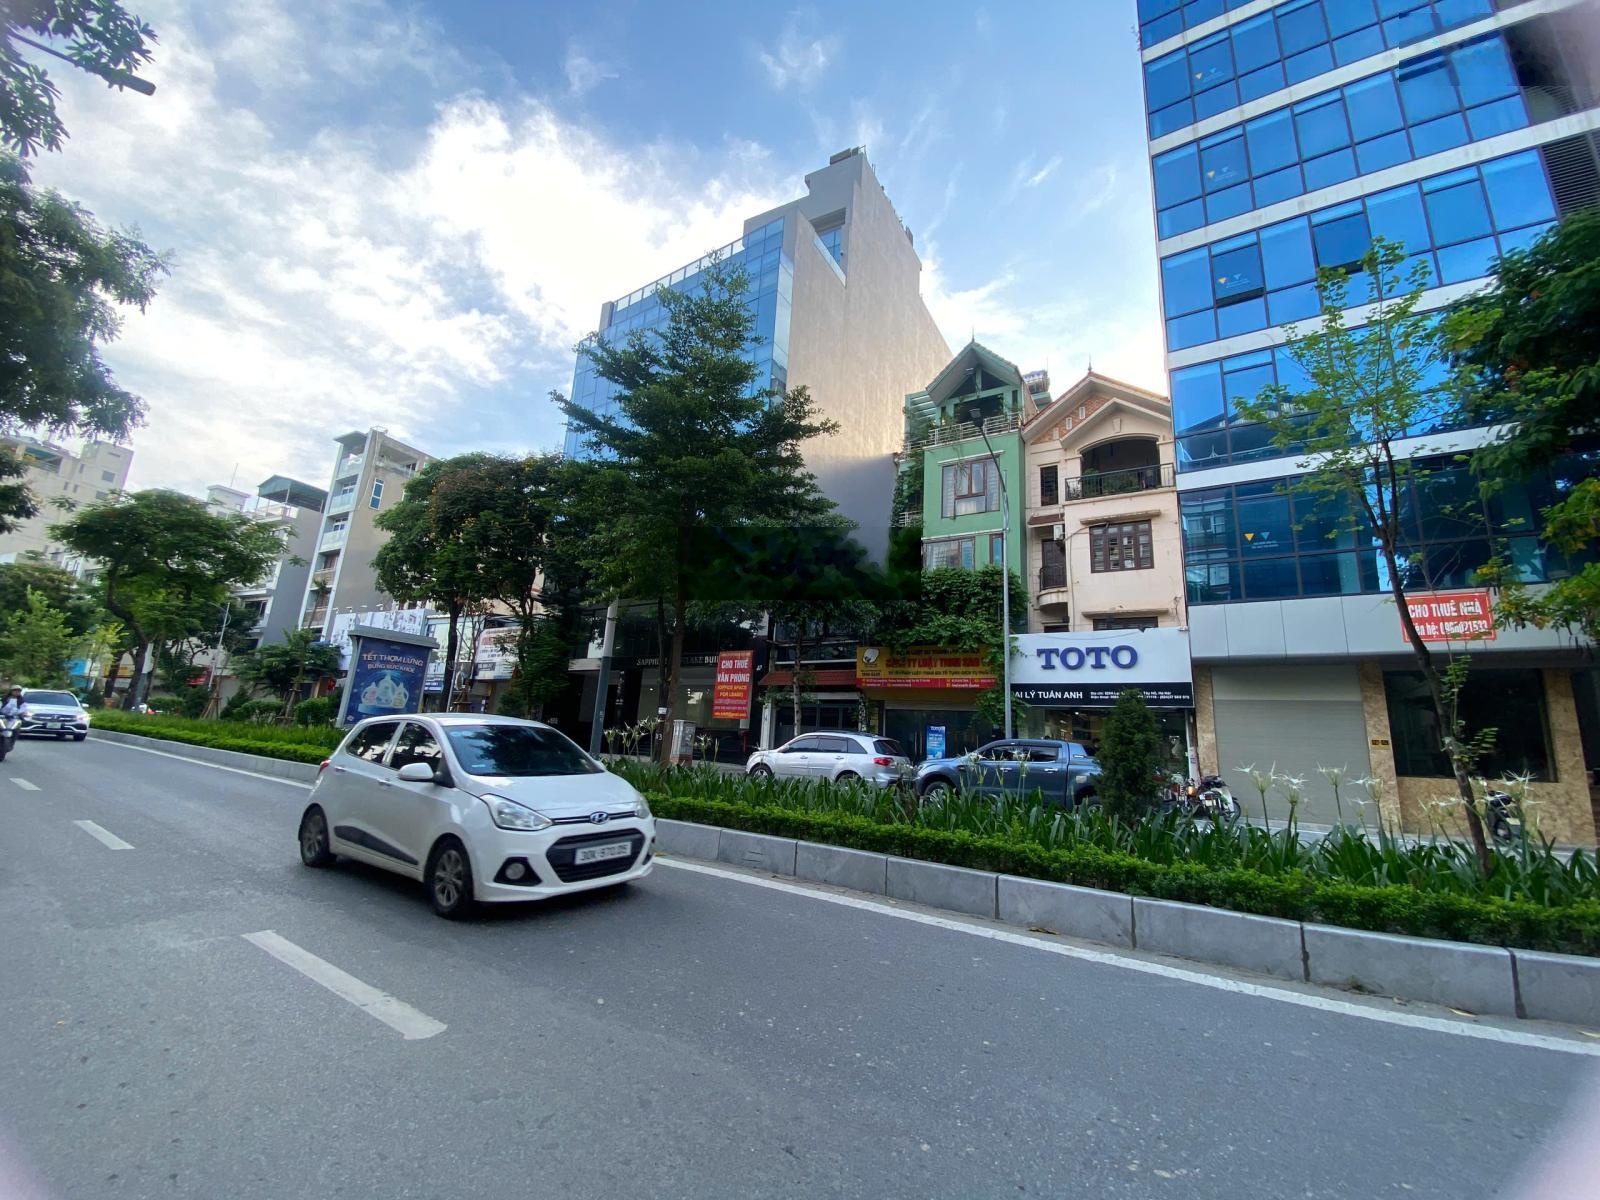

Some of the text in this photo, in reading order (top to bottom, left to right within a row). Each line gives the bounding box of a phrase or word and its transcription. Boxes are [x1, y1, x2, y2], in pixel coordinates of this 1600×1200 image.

[1408, 604, 1429, 618] CHO
[1430, 600, 1458, 617] THUÊ
[721, 659, 733, 669] CHO
[1037, 645, 1138, 670] TOTO
[1024, 690, 1035, 699] LÝ
[1063, 691, 1083, 699] ANH
